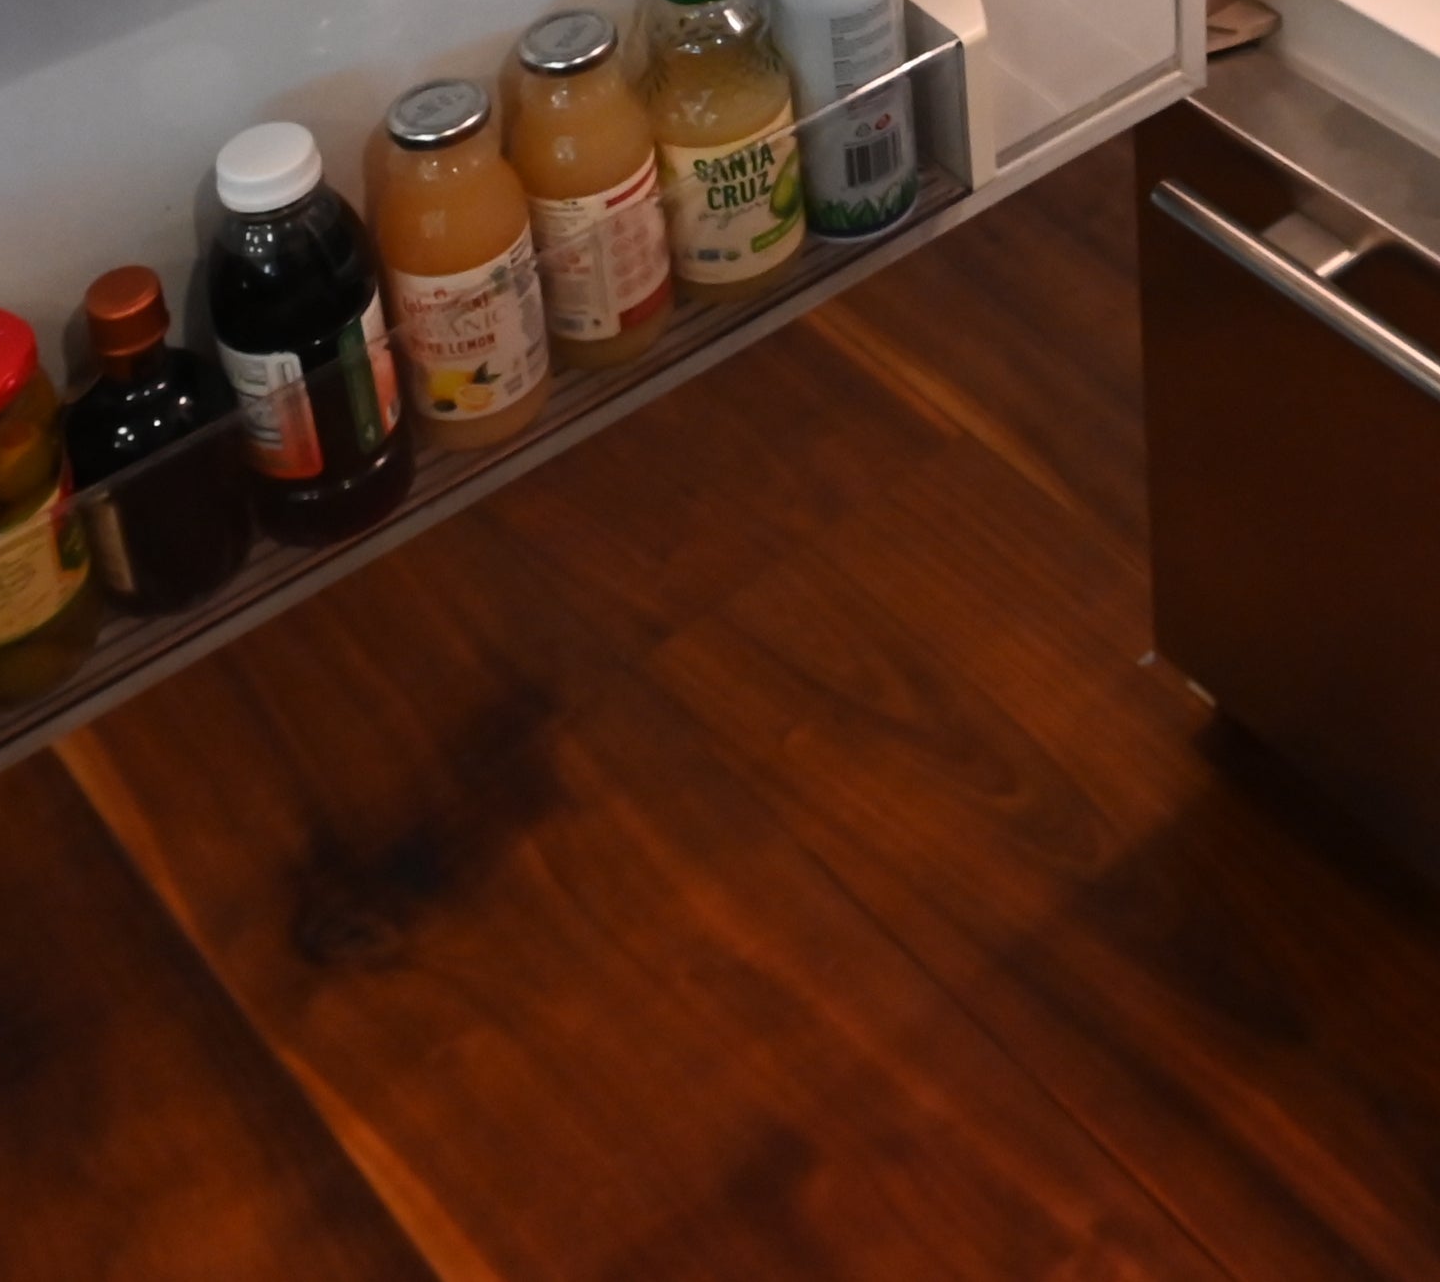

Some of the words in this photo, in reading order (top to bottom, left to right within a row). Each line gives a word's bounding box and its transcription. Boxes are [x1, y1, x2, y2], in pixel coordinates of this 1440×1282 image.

[693, 142, 775, 185] SANTA
[707, 171, 773, 211] CRUZ
[448, 333, 495, 355] LEMON
